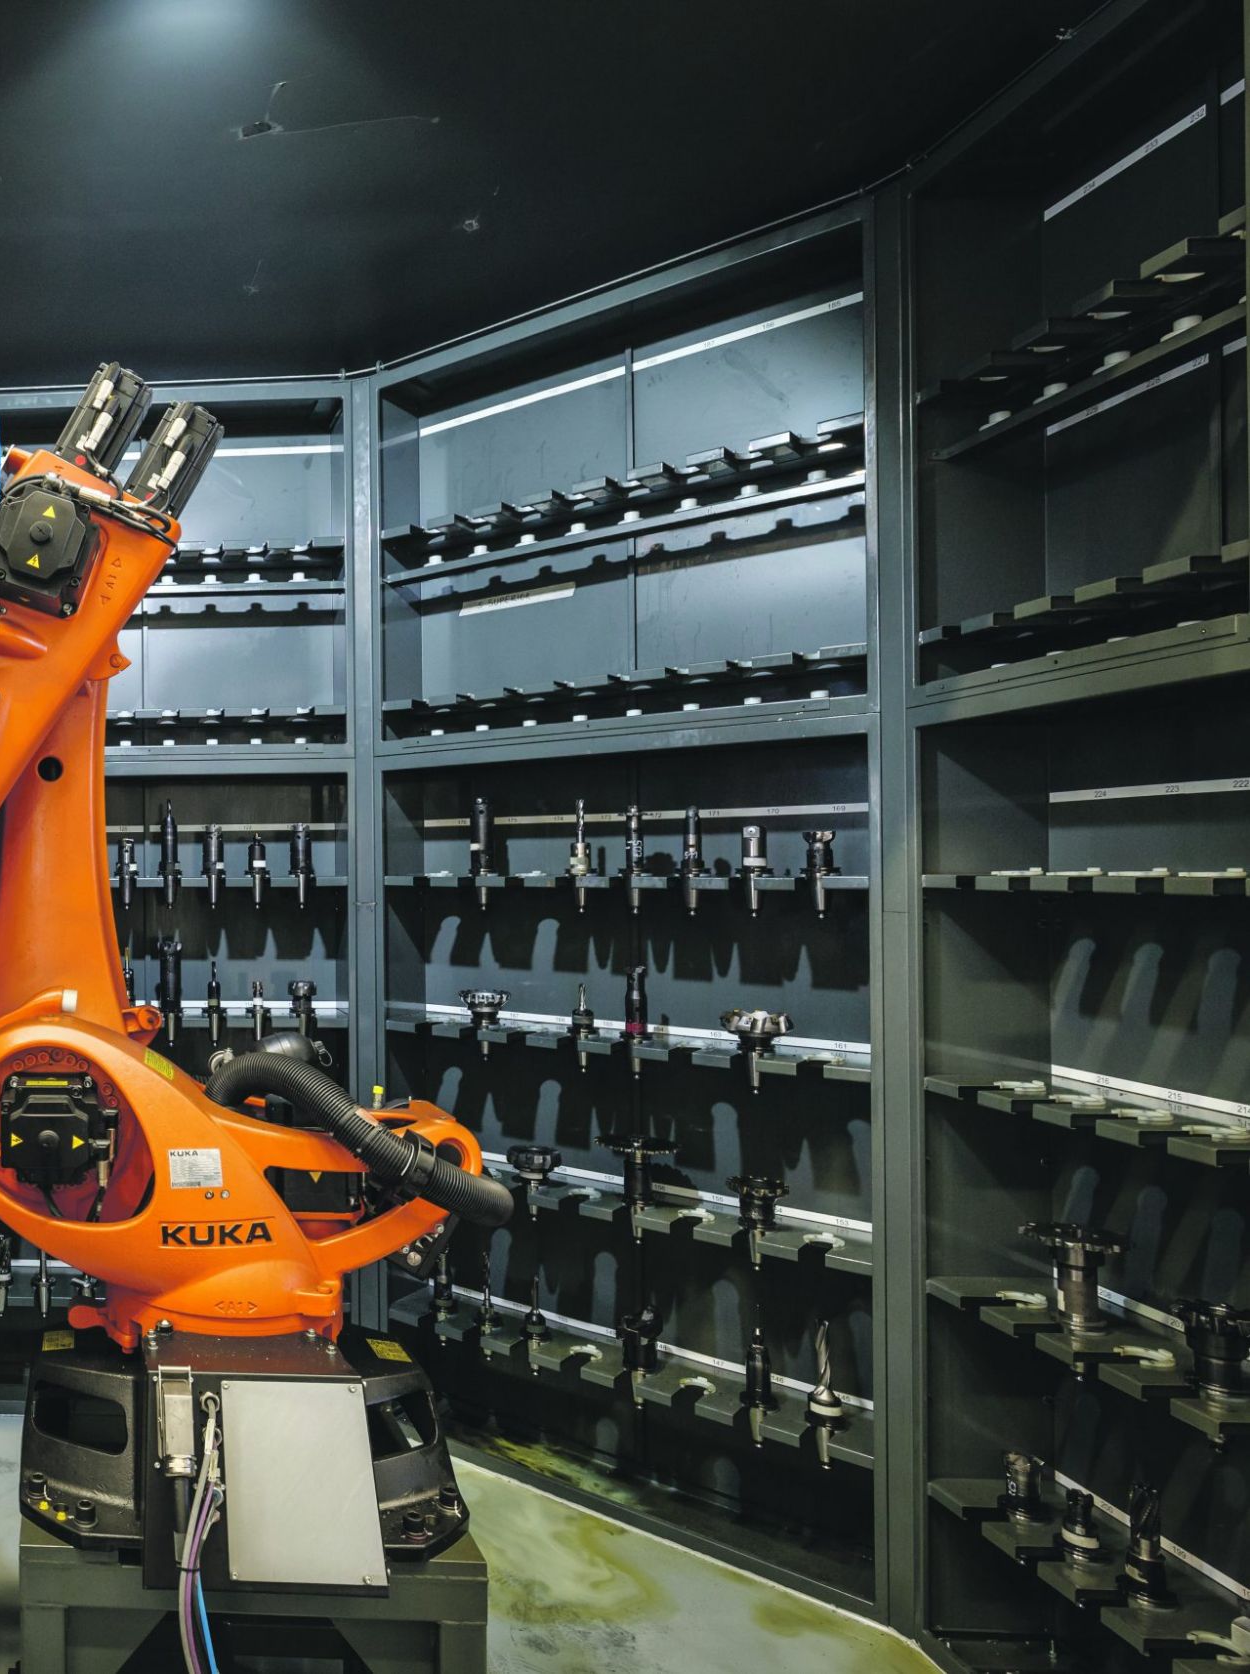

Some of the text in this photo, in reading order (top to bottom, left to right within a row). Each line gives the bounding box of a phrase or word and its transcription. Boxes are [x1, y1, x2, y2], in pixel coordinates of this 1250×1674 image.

[1189, 108, 1205, 124] 232
[1094, 780, 1250, 798] 224 223 222
[1096, 1076, 1109, 1085] 216
[1167, 1091, 1182, 1101] 215
[836, 1218, 849, 1226] 153
[161, 1222, 272, 1246] KUKA
[713, 1359, 724, 1367] 147
